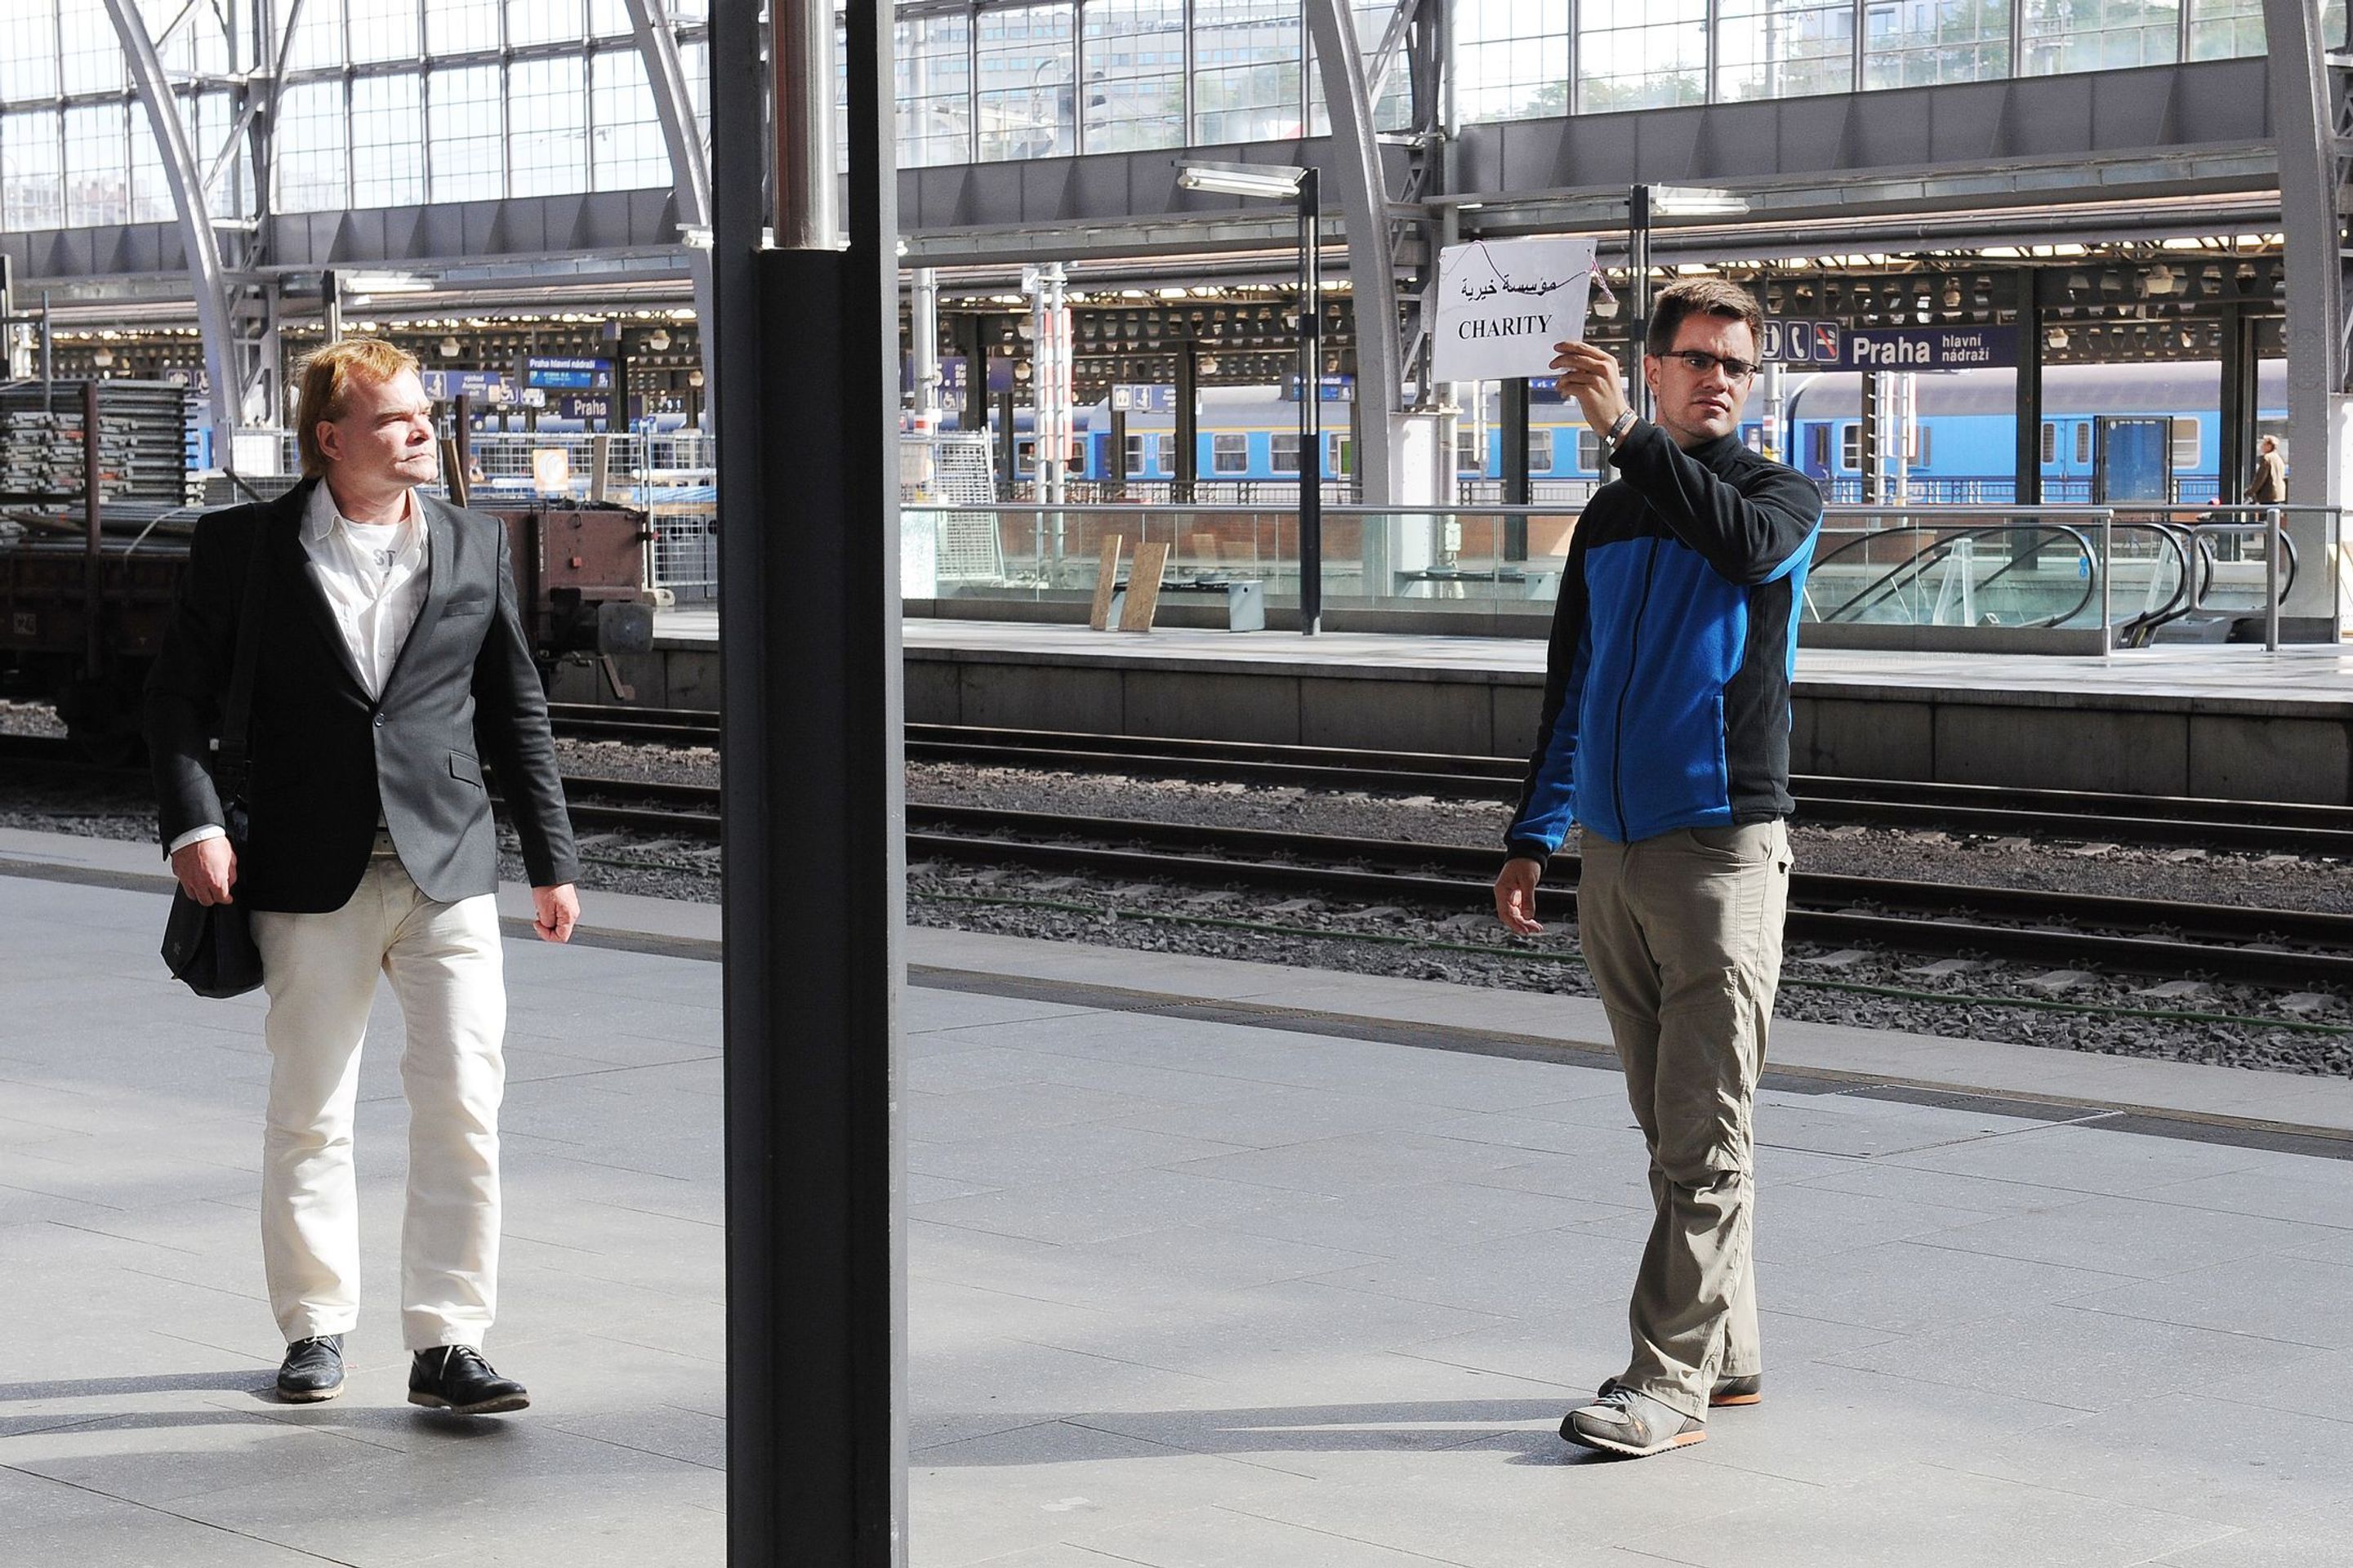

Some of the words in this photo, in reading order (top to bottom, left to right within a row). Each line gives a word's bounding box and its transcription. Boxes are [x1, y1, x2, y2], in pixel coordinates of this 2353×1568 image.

[1461, 278, 1498, 301] خيرية
[1459, 314, 1553, 340] CHARITY
[1852, 336, 1931, 365] Praha
[1942, 333, 1982, 349] hlavní
[1941, 347, 1990, 362] nádraží
[573, 399, 607, 416] Praha
